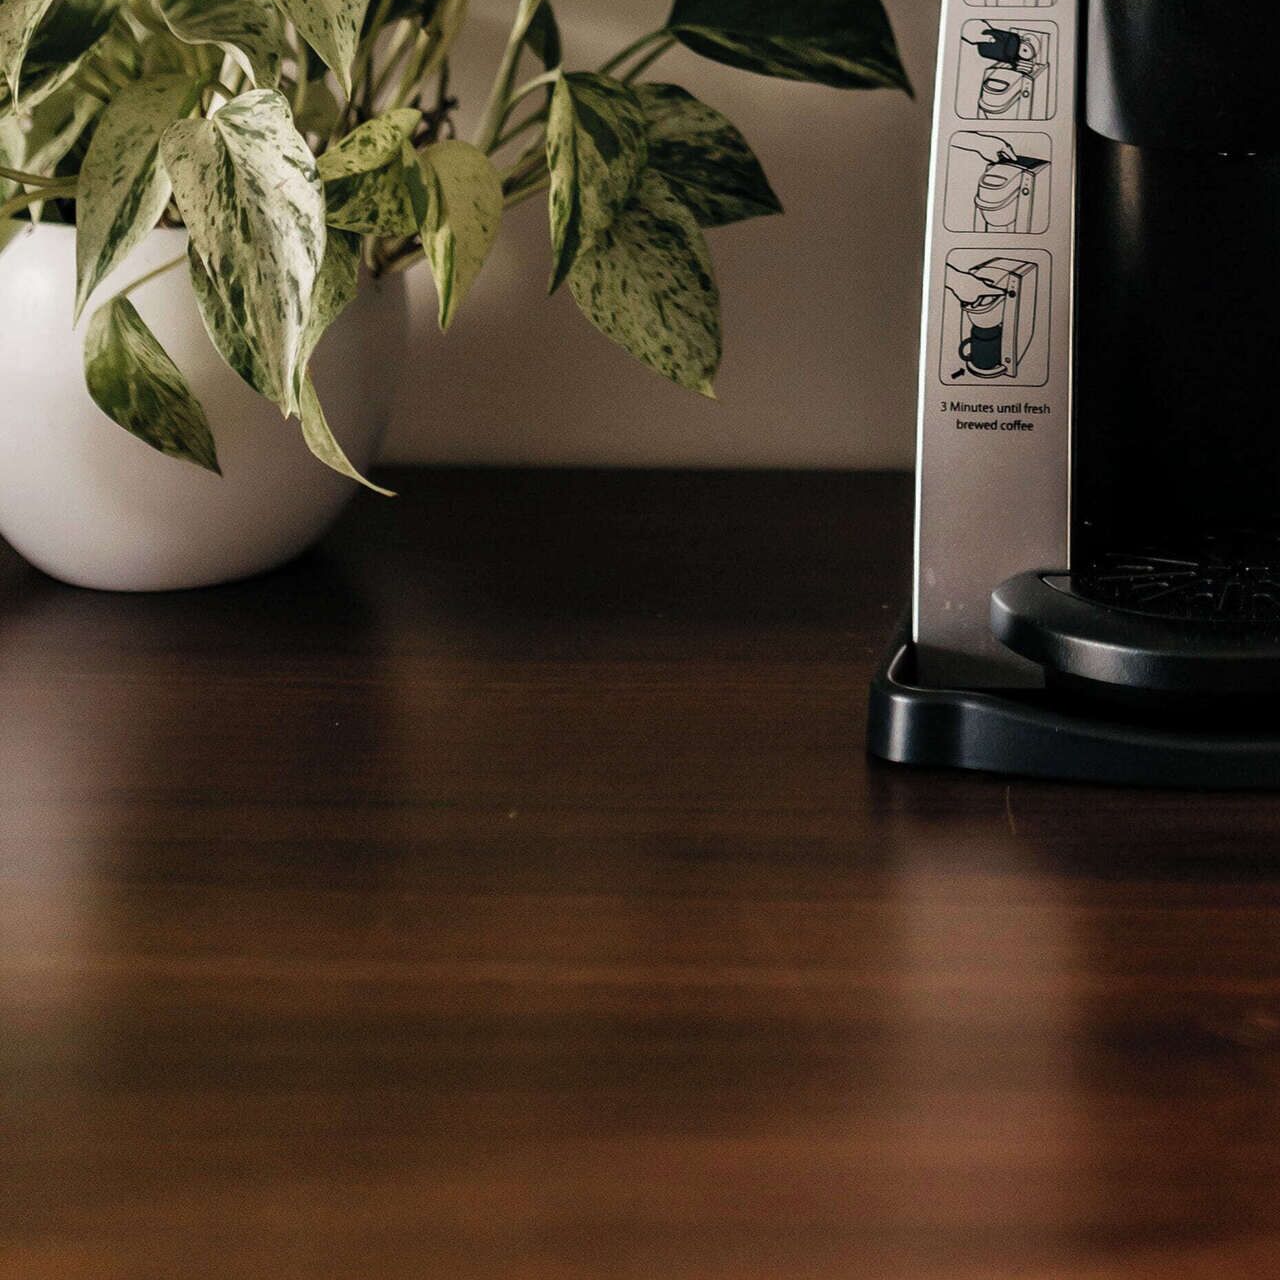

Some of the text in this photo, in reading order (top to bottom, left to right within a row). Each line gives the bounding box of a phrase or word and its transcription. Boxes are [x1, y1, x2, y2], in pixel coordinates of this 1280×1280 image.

[940, 401, 1051, 414] 3 Minutes until fresh
[956, 419, 1034, 431] brewed coffee
